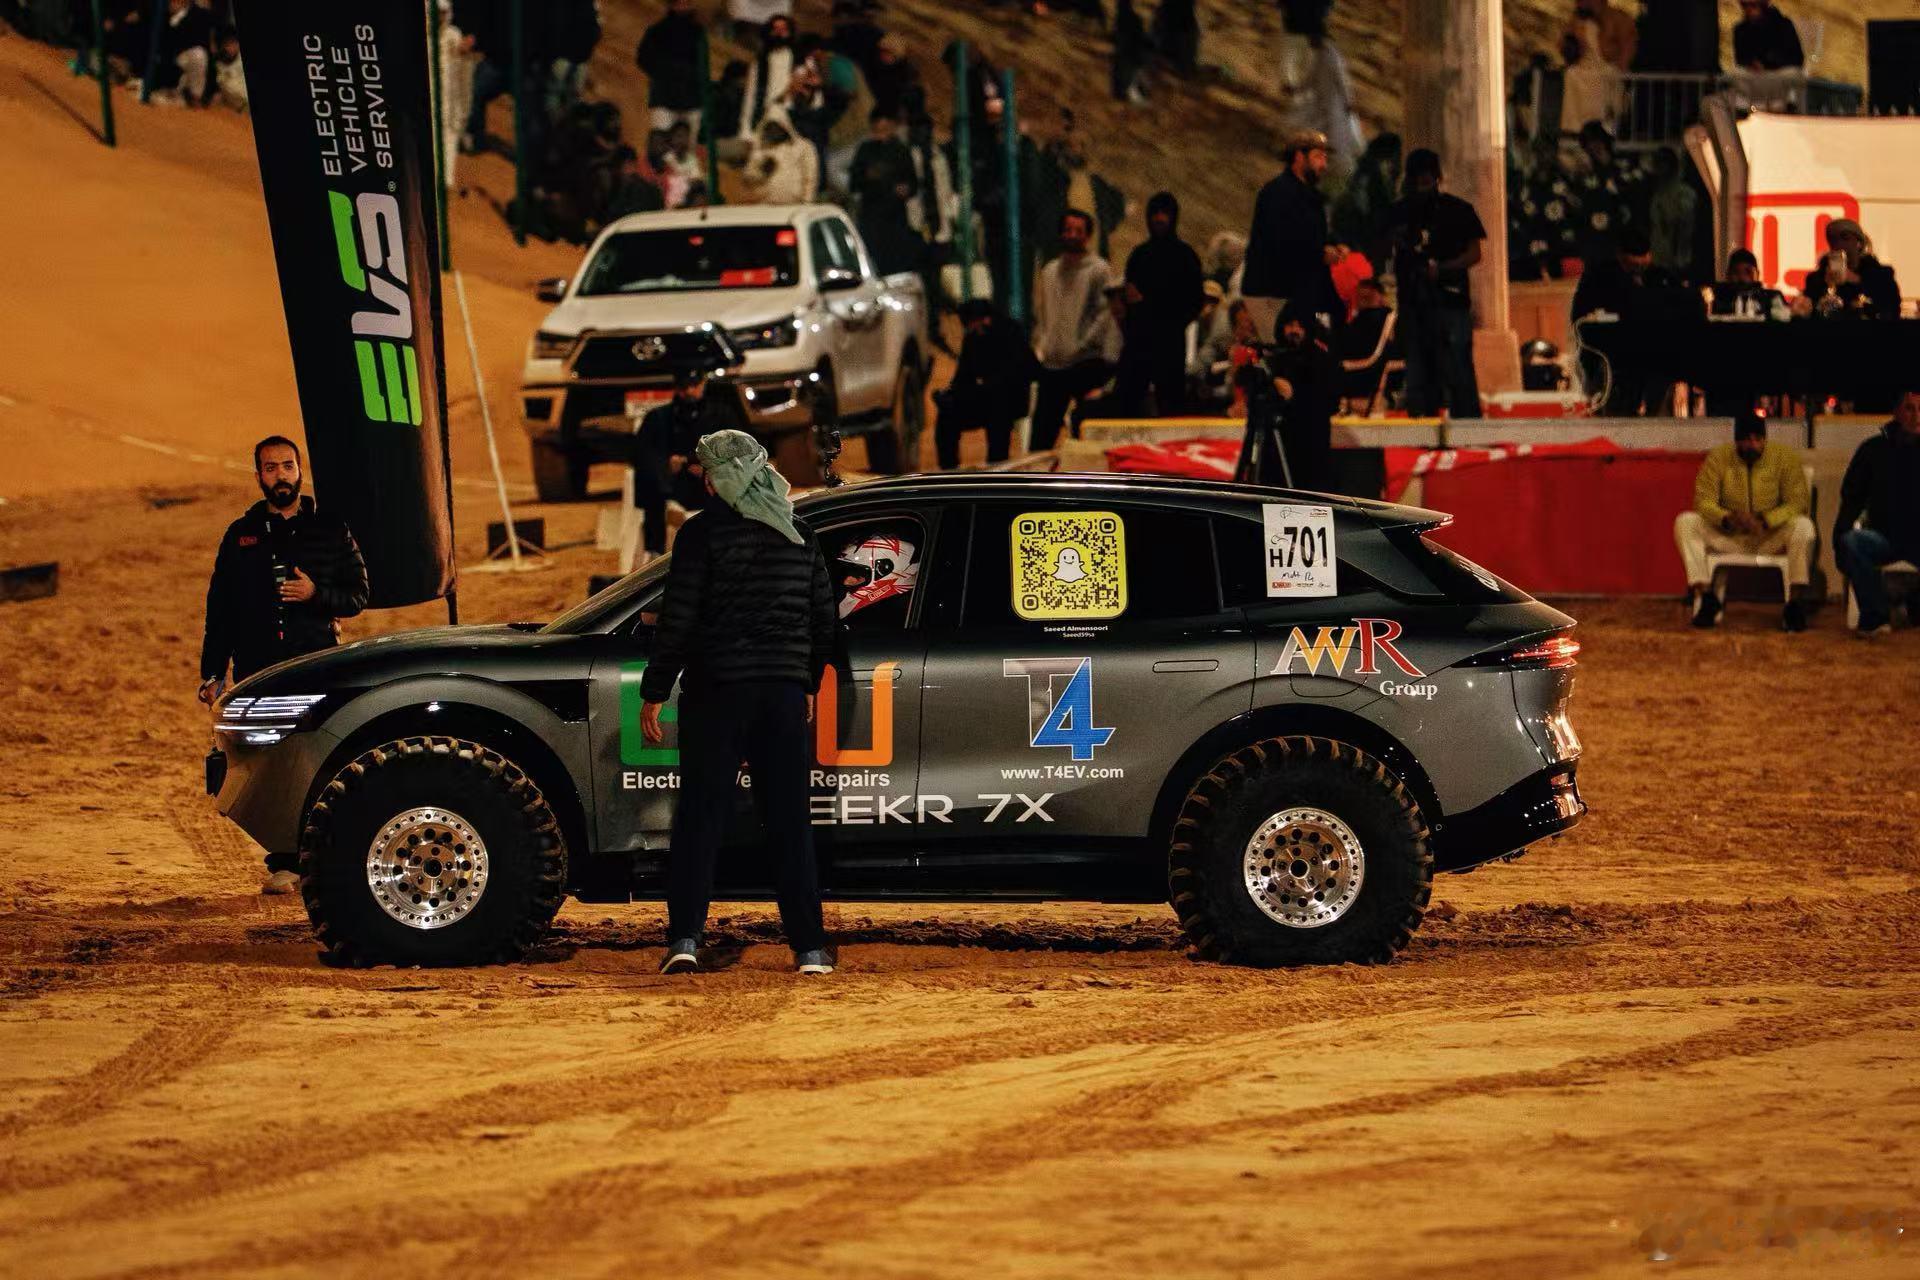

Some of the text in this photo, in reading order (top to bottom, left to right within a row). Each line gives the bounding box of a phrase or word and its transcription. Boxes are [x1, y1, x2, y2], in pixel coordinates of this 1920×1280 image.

[303, 35, 343, 175] ELECTRIC
[331, 46, 368, 173] VEHICLE
[354, 24, 394, 168] SERVICES
[328, 190, 423, 427] EVS
[1270, 618, 1427, 677] AWR
[1003, 656, 1117, 761] T4
[1379, 680, 1438, 700] Group
[809, 792, 1056, 825] EEKR 7X
[810, 769, 890, 791] Repairs
[1001, 765, 1124, 780] www.T4EV.com
